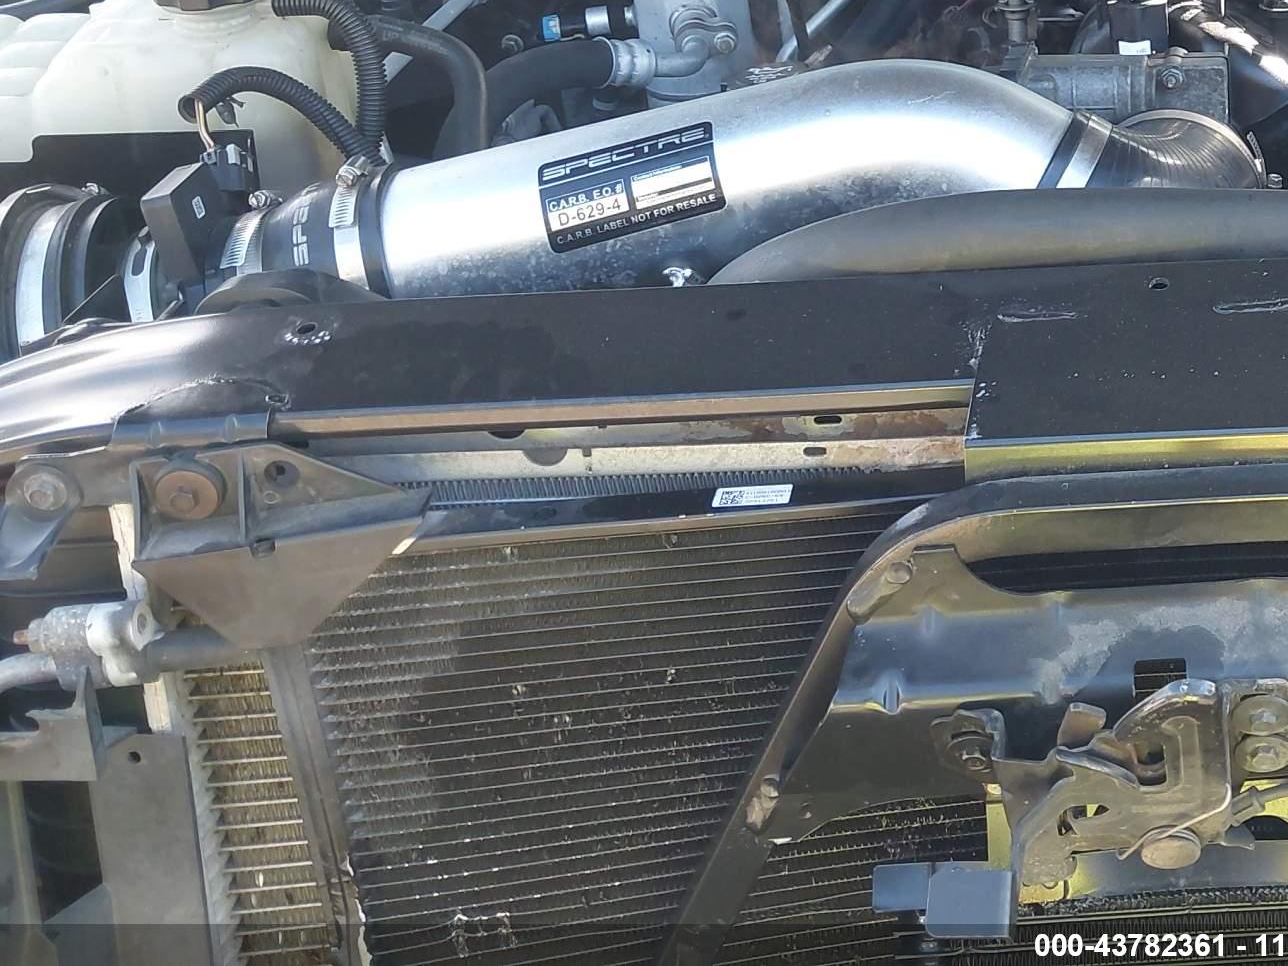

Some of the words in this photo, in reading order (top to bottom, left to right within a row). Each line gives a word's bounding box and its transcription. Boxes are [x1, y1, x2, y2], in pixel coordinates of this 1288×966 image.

[542, 127, 705, 181] SPECTRE
[549, 194, 590, 212] C.A.R.B.
[557, 228, 595, 244] C.A.R.B.
[597, 218, 629, 233] LABEL
[631, 213, 651, 225] NOT
[653, 205, 675, 218] FOR
[677, 193, 717, 211] RESALE
[558, 200, 621, 226] D-629-4
